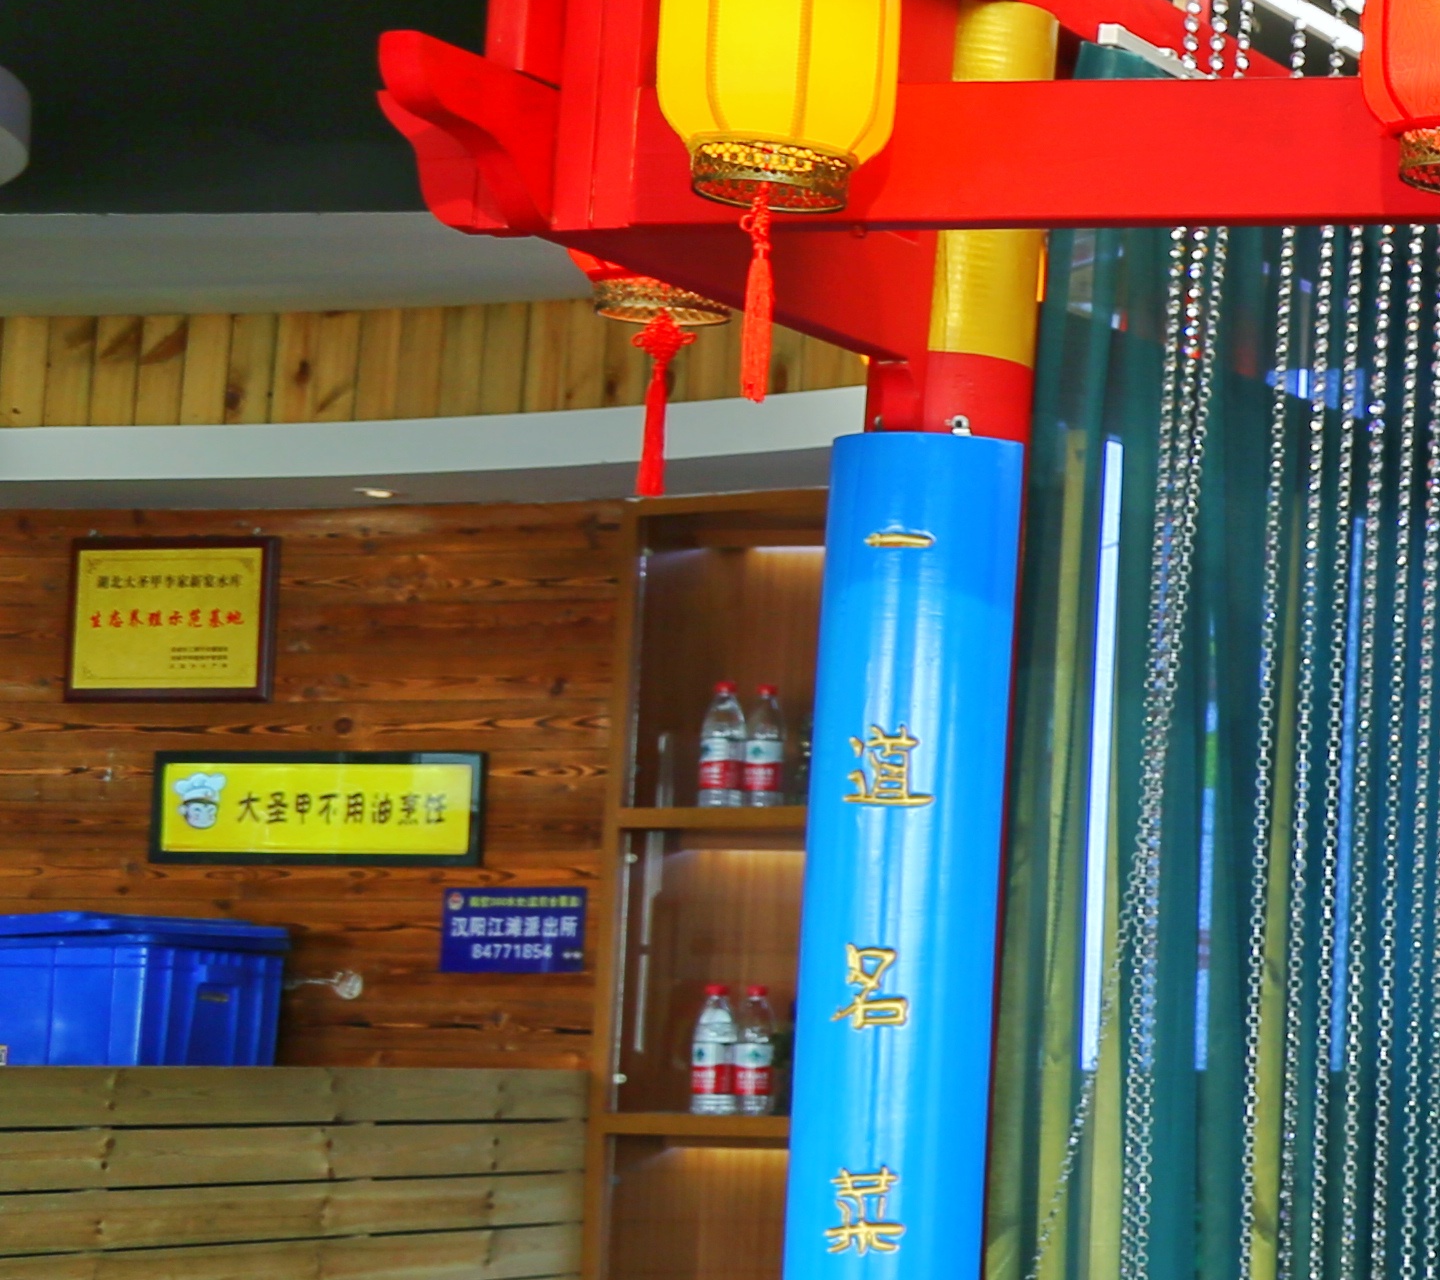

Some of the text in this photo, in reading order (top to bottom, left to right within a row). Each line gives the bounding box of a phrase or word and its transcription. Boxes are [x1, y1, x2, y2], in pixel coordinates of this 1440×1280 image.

[237, 790, 448, 826] 大圣甲不用油烹饪
[450, 915, 578, 937] 汉阳江滩派出所
[470, 943, 554, 959] 84771854
